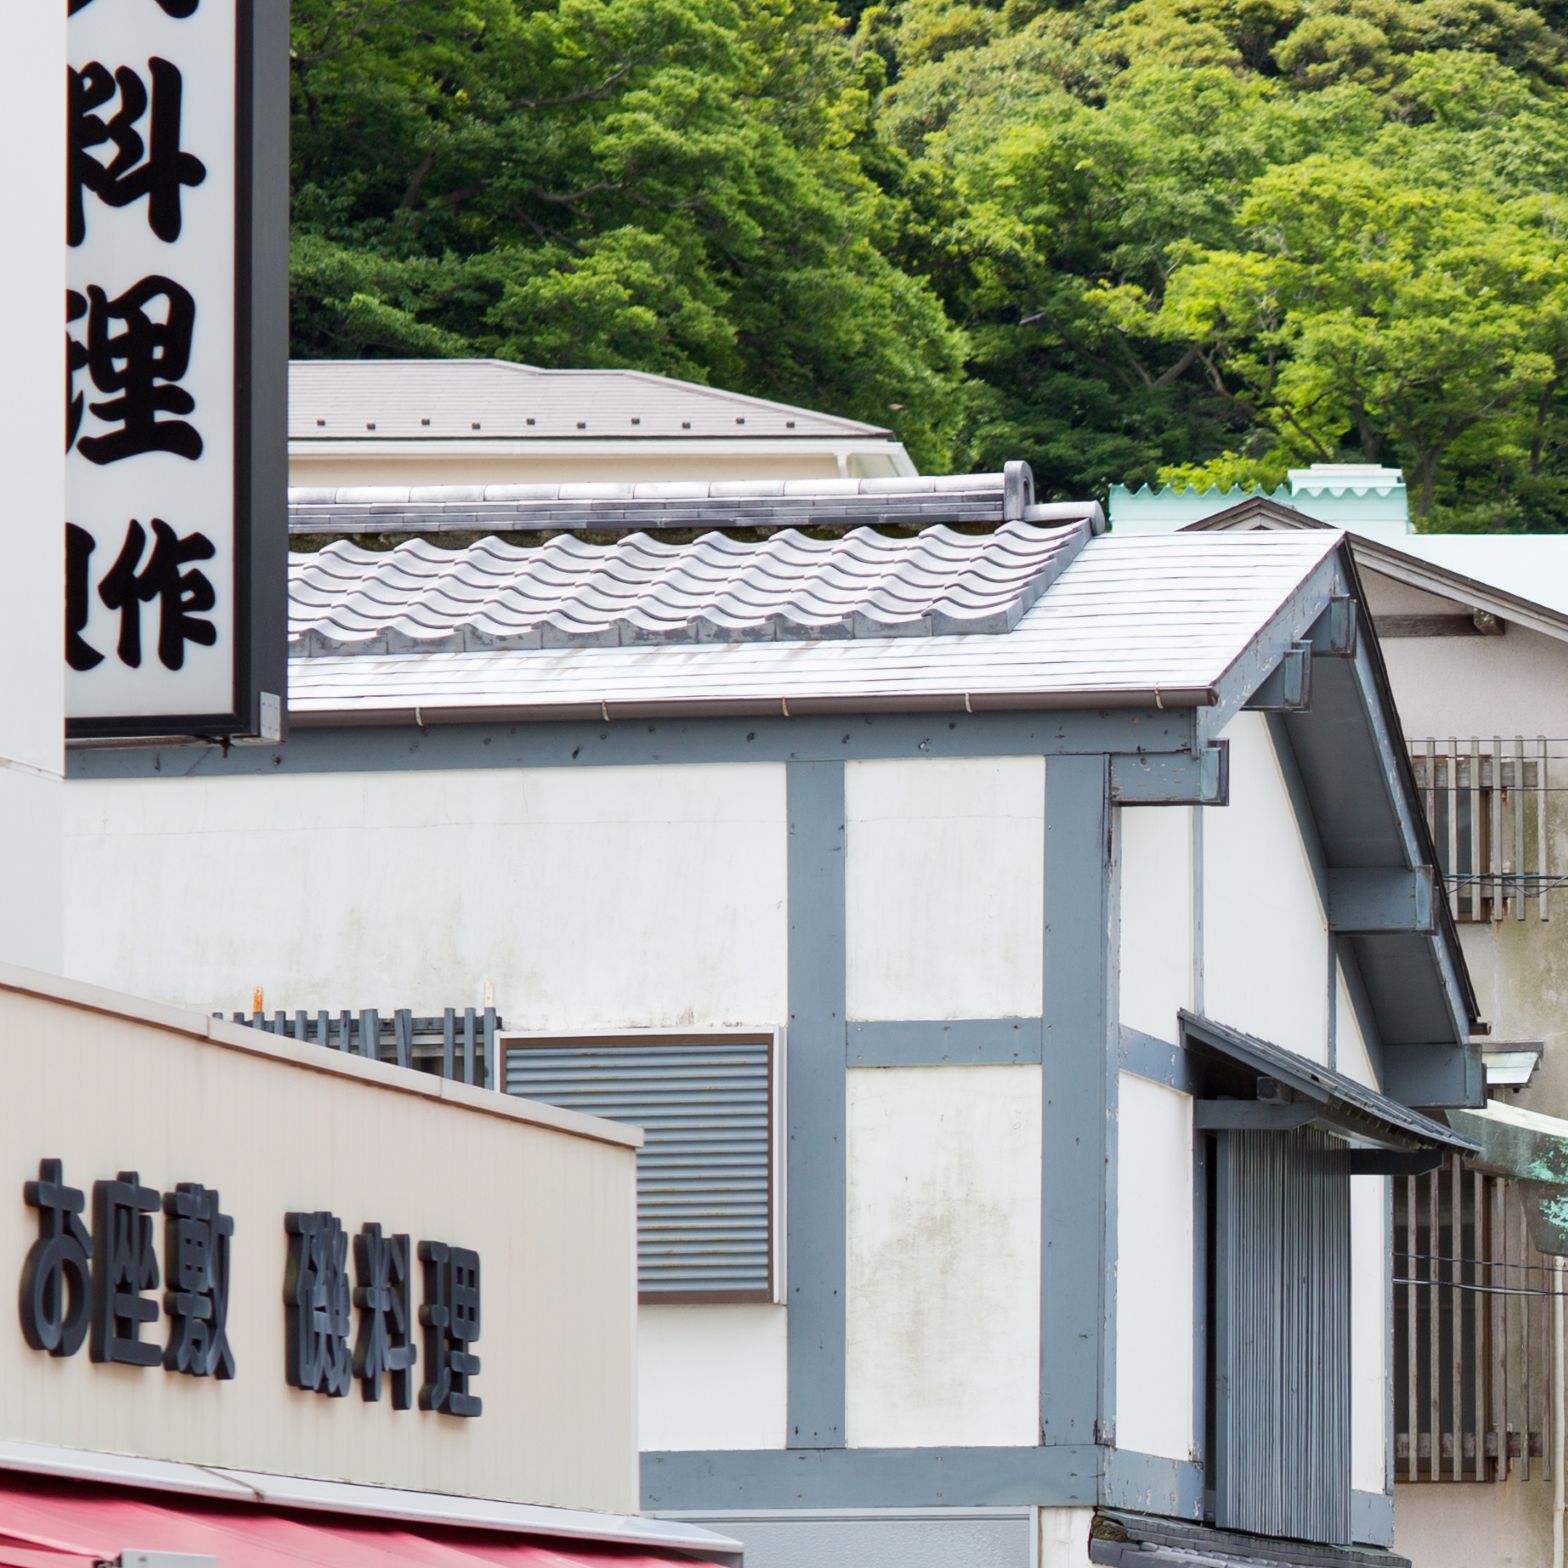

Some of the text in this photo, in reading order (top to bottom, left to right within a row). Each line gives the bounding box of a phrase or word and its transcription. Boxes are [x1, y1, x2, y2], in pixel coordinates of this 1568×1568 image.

[67, 0, 205, 466] 料理
[19, 1158, 483, 1418] お座敷 磯料理
